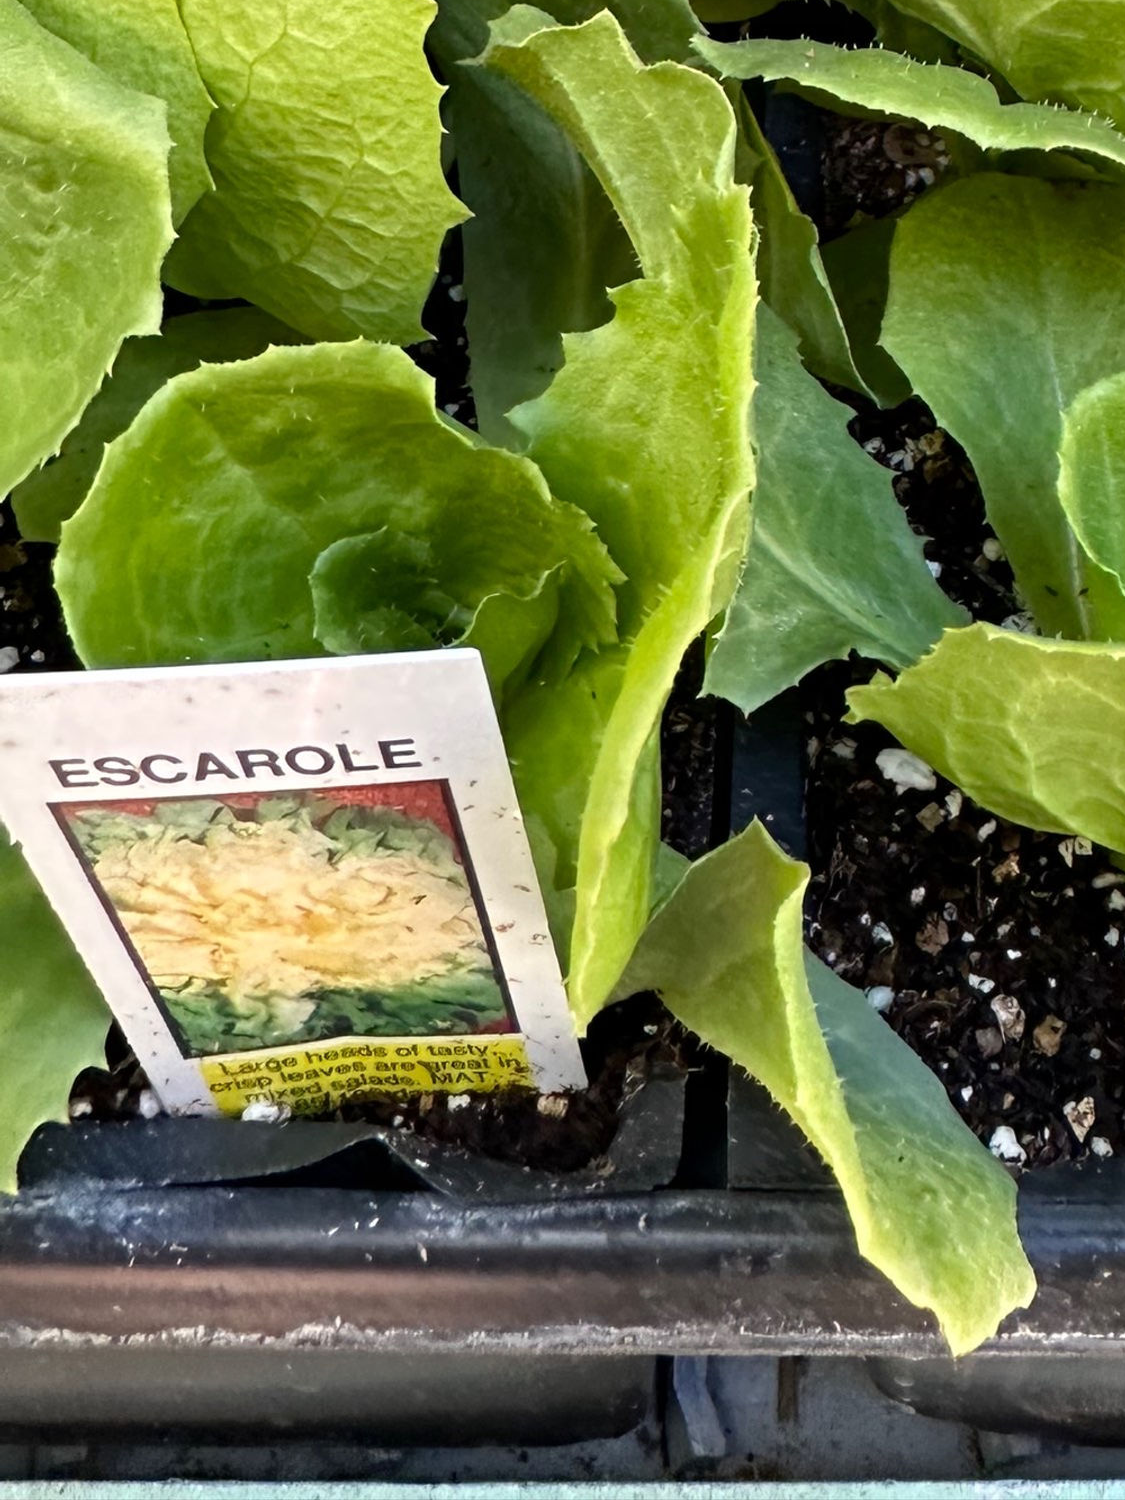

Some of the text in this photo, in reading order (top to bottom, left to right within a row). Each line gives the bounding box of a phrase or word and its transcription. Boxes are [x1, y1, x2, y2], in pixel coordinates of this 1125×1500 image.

[48, 738, 423, 788] ESCAROLE
[210, 1075, 272, 1093] crisp
[280, 1060, 367, 1083] leaves
[375, 1060, 416, 1072] are
[498, 1056, 521, 1069] in
[218, 1056, 298, 1076] Large
[305, 1043, 388, 1064] heads
[395, 1044, 418, 1057] of
